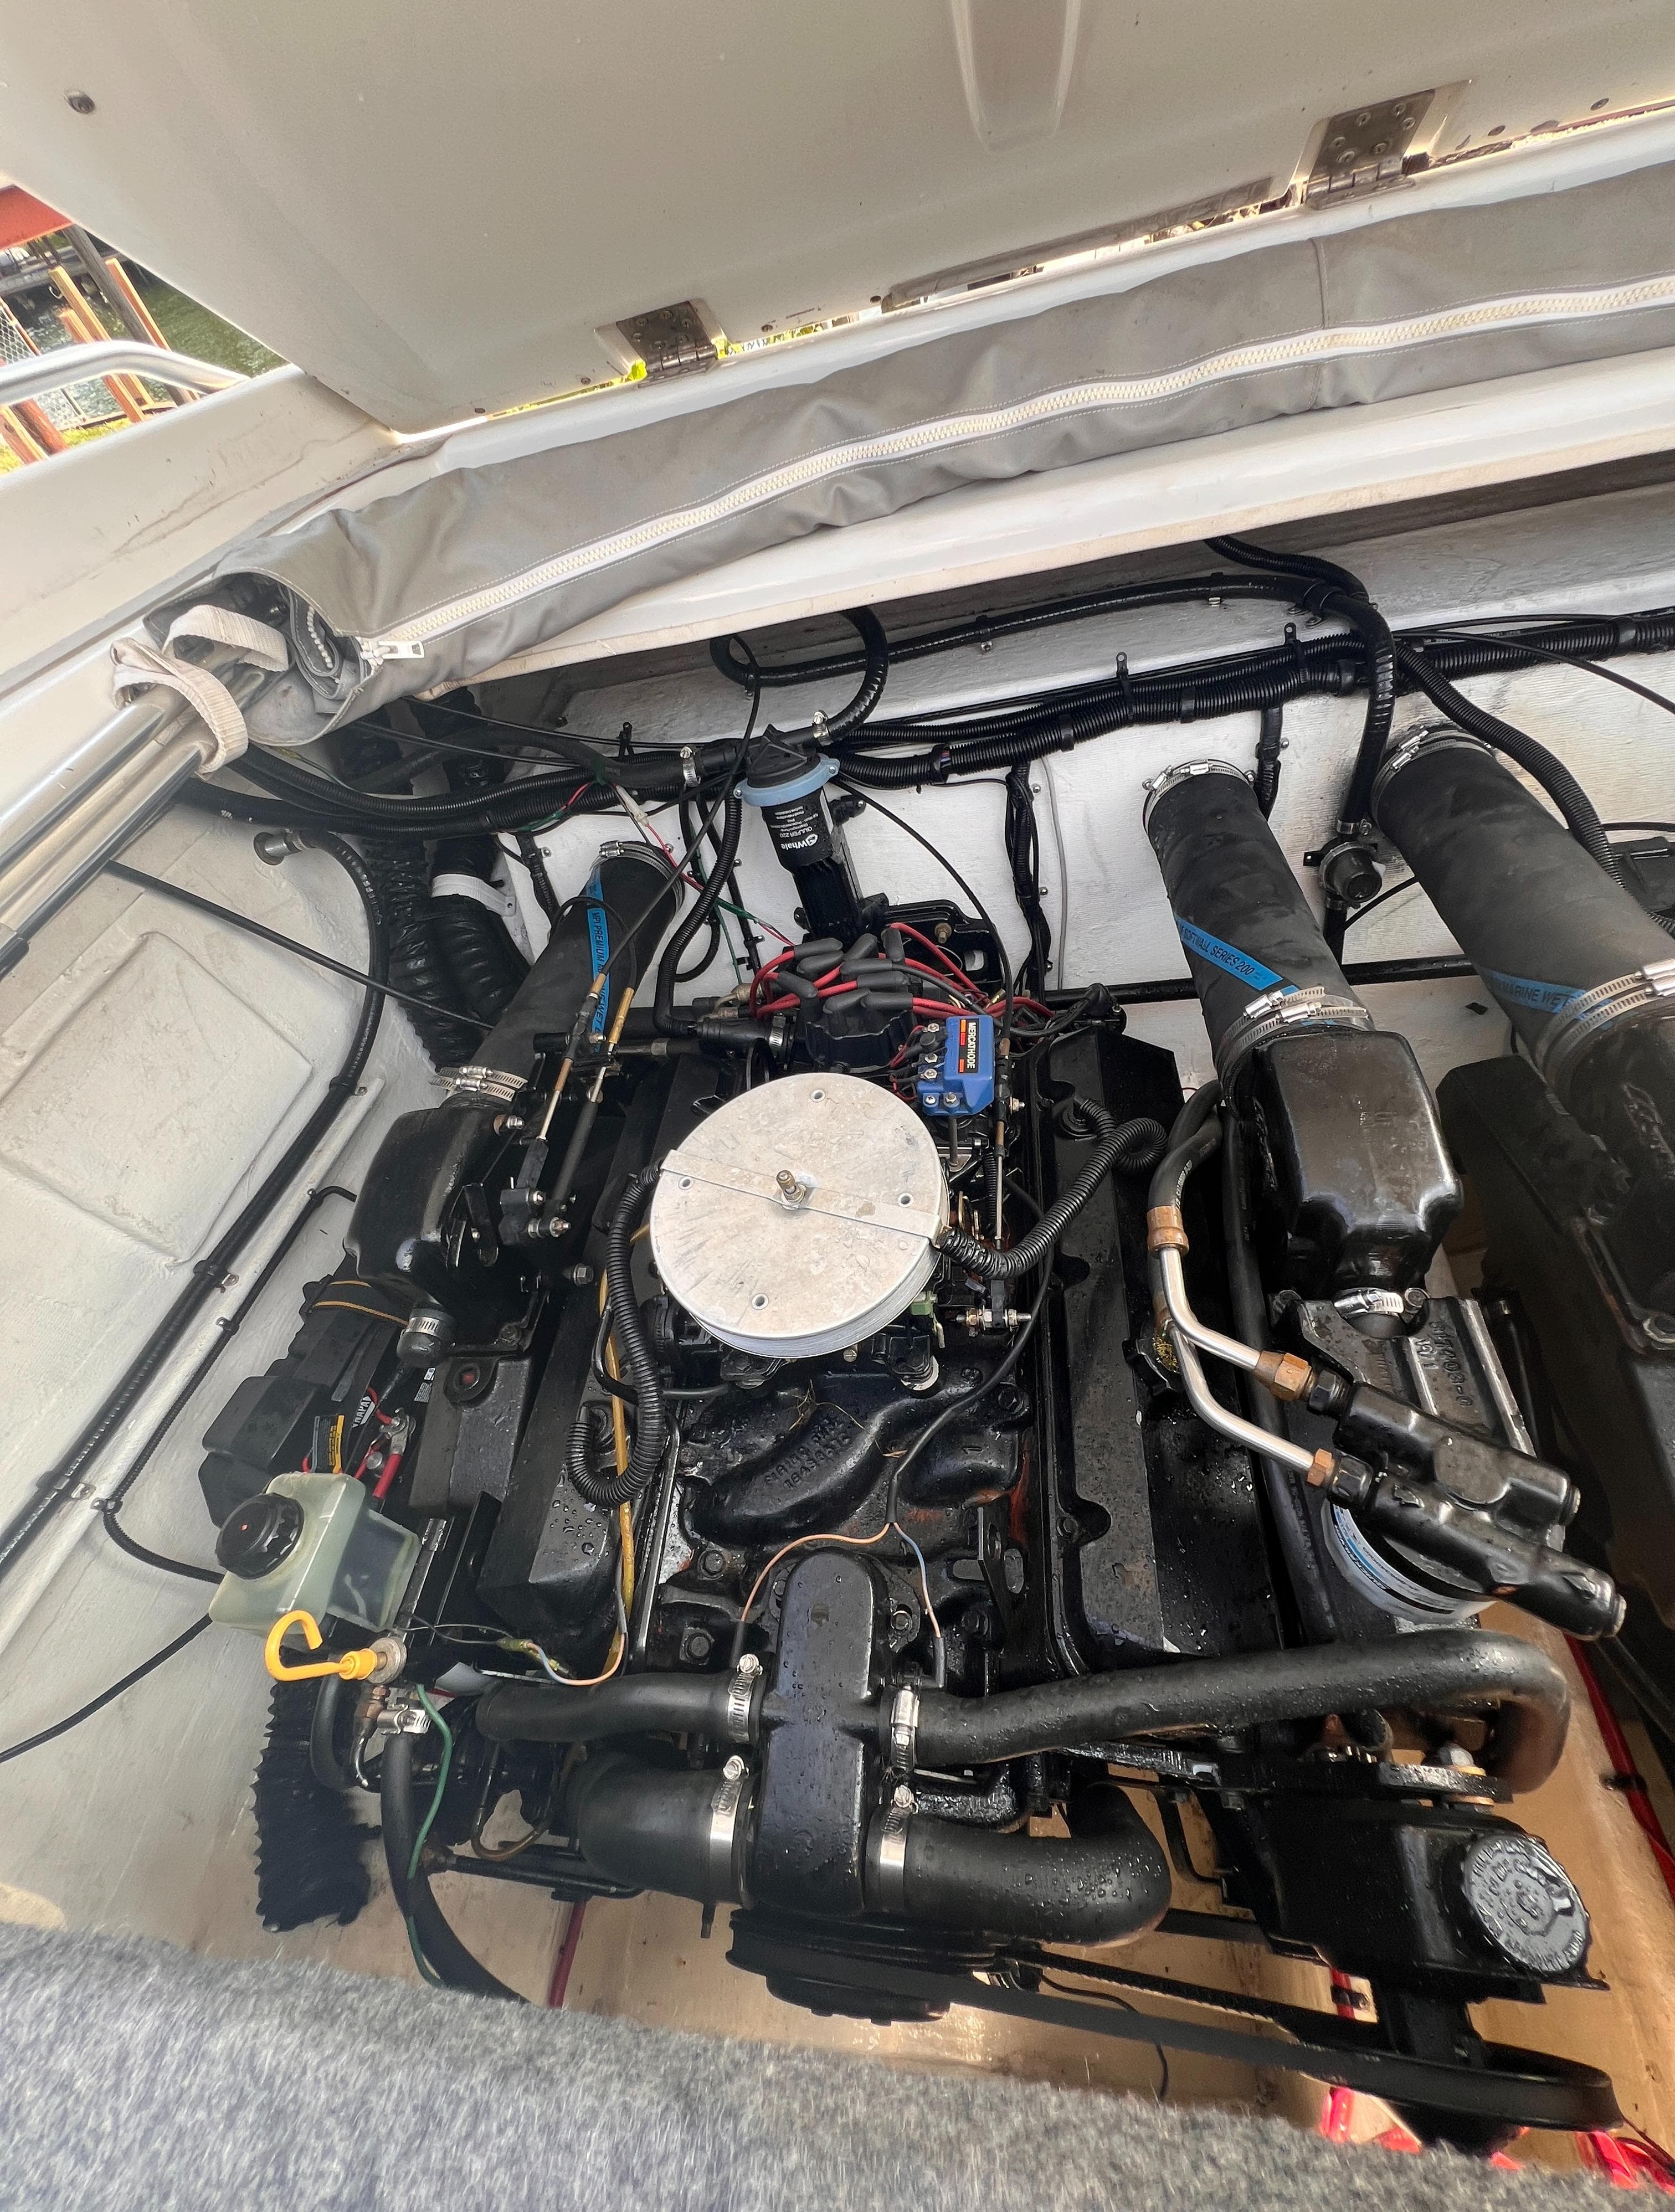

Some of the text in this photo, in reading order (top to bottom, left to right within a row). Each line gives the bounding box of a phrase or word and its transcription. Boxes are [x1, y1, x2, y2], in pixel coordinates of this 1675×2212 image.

[790, 826, 813, 837] GULPER
[780, 840, 808, 851] Whale
[594, 925, 605, 963] PREMIUM
[1210, 945, 1240, 966] SERIES
[1235, 961, 1256, 975] 200
[595, 1003, 605, 1027] WET
[967, 1022, 977, 1069] MERCATHODE
[354, 1401, 371, 1423] NAPA
